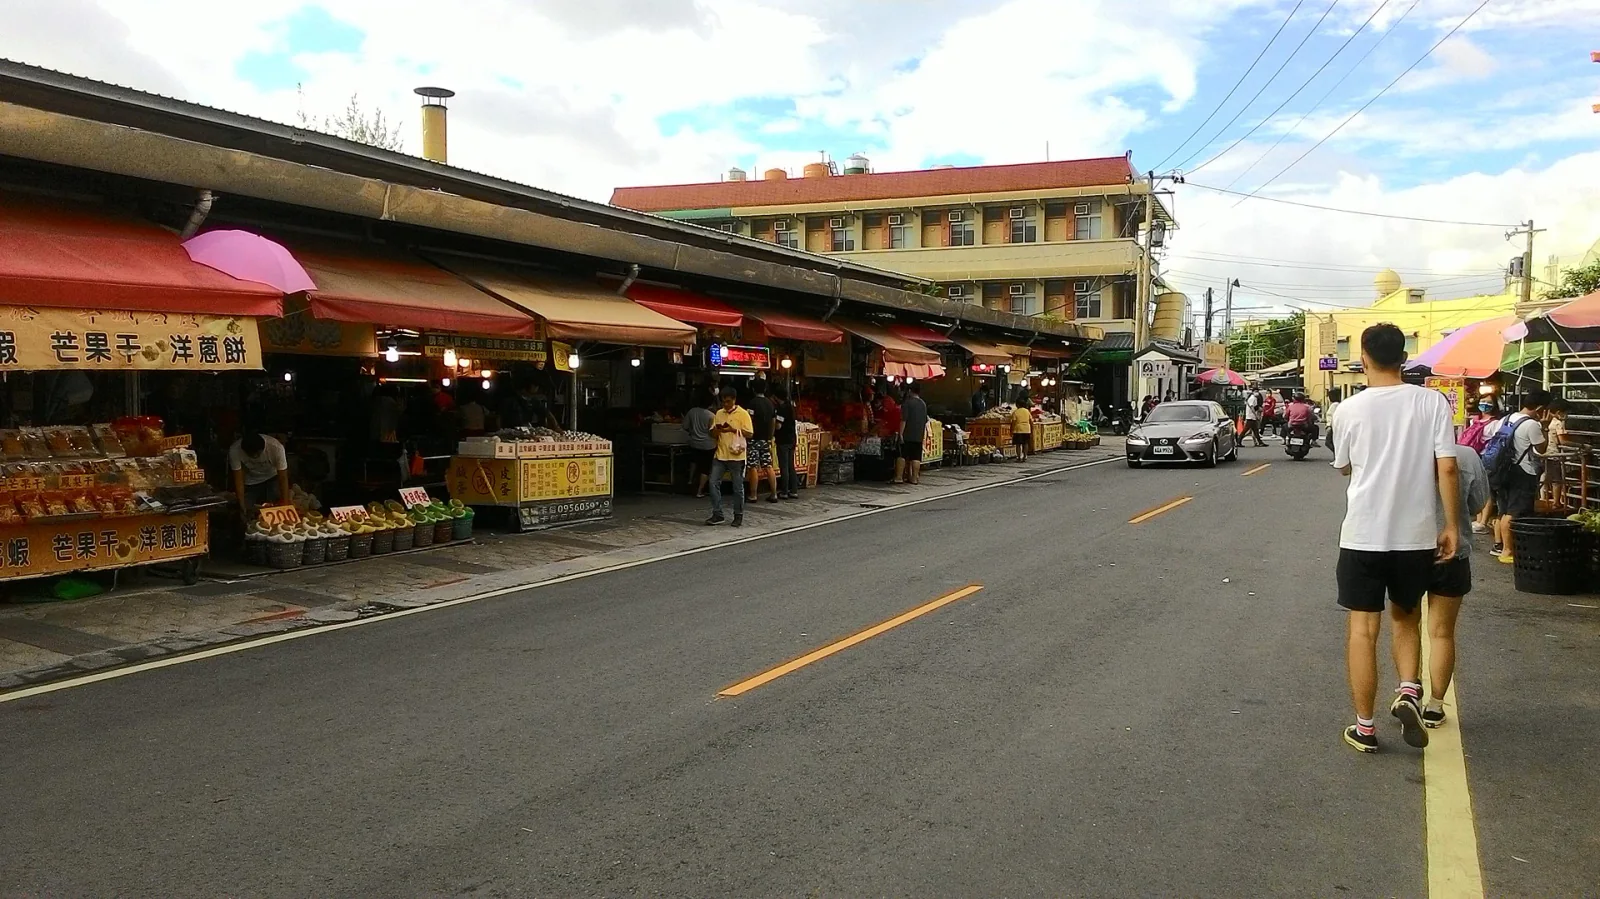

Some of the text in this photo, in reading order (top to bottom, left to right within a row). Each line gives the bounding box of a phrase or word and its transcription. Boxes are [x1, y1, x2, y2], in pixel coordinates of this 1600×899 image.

[50, 331, 142, 364] 芒果干
[170, 333, 248, 365] 洋蔥餅
[265, 508, 299, 525] 200
[0, 521, 197, 567] 蝦 芒果干 洋蔥餅
